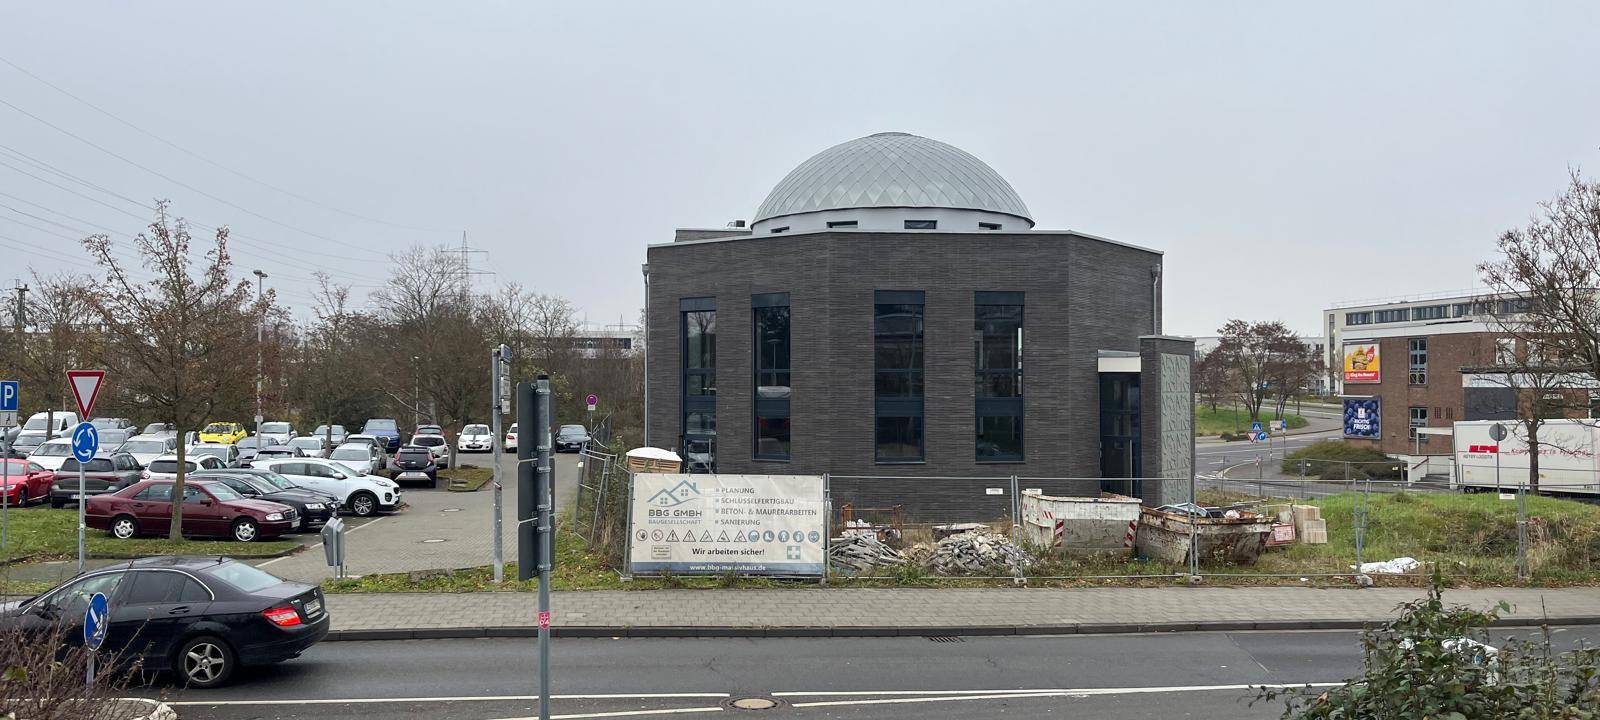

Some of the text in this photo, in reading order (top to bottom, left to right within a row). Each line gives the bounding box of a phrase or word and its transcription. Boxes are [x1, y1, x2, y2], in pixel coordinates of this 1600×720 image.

[4, 384, 14, 408] P
[648, 509, 703, 517] BBG GMBH
[755, 508, 817, 516] MAURERARBEITEN
[692, 547, 765, 556] Wir arbeiten sicher!
